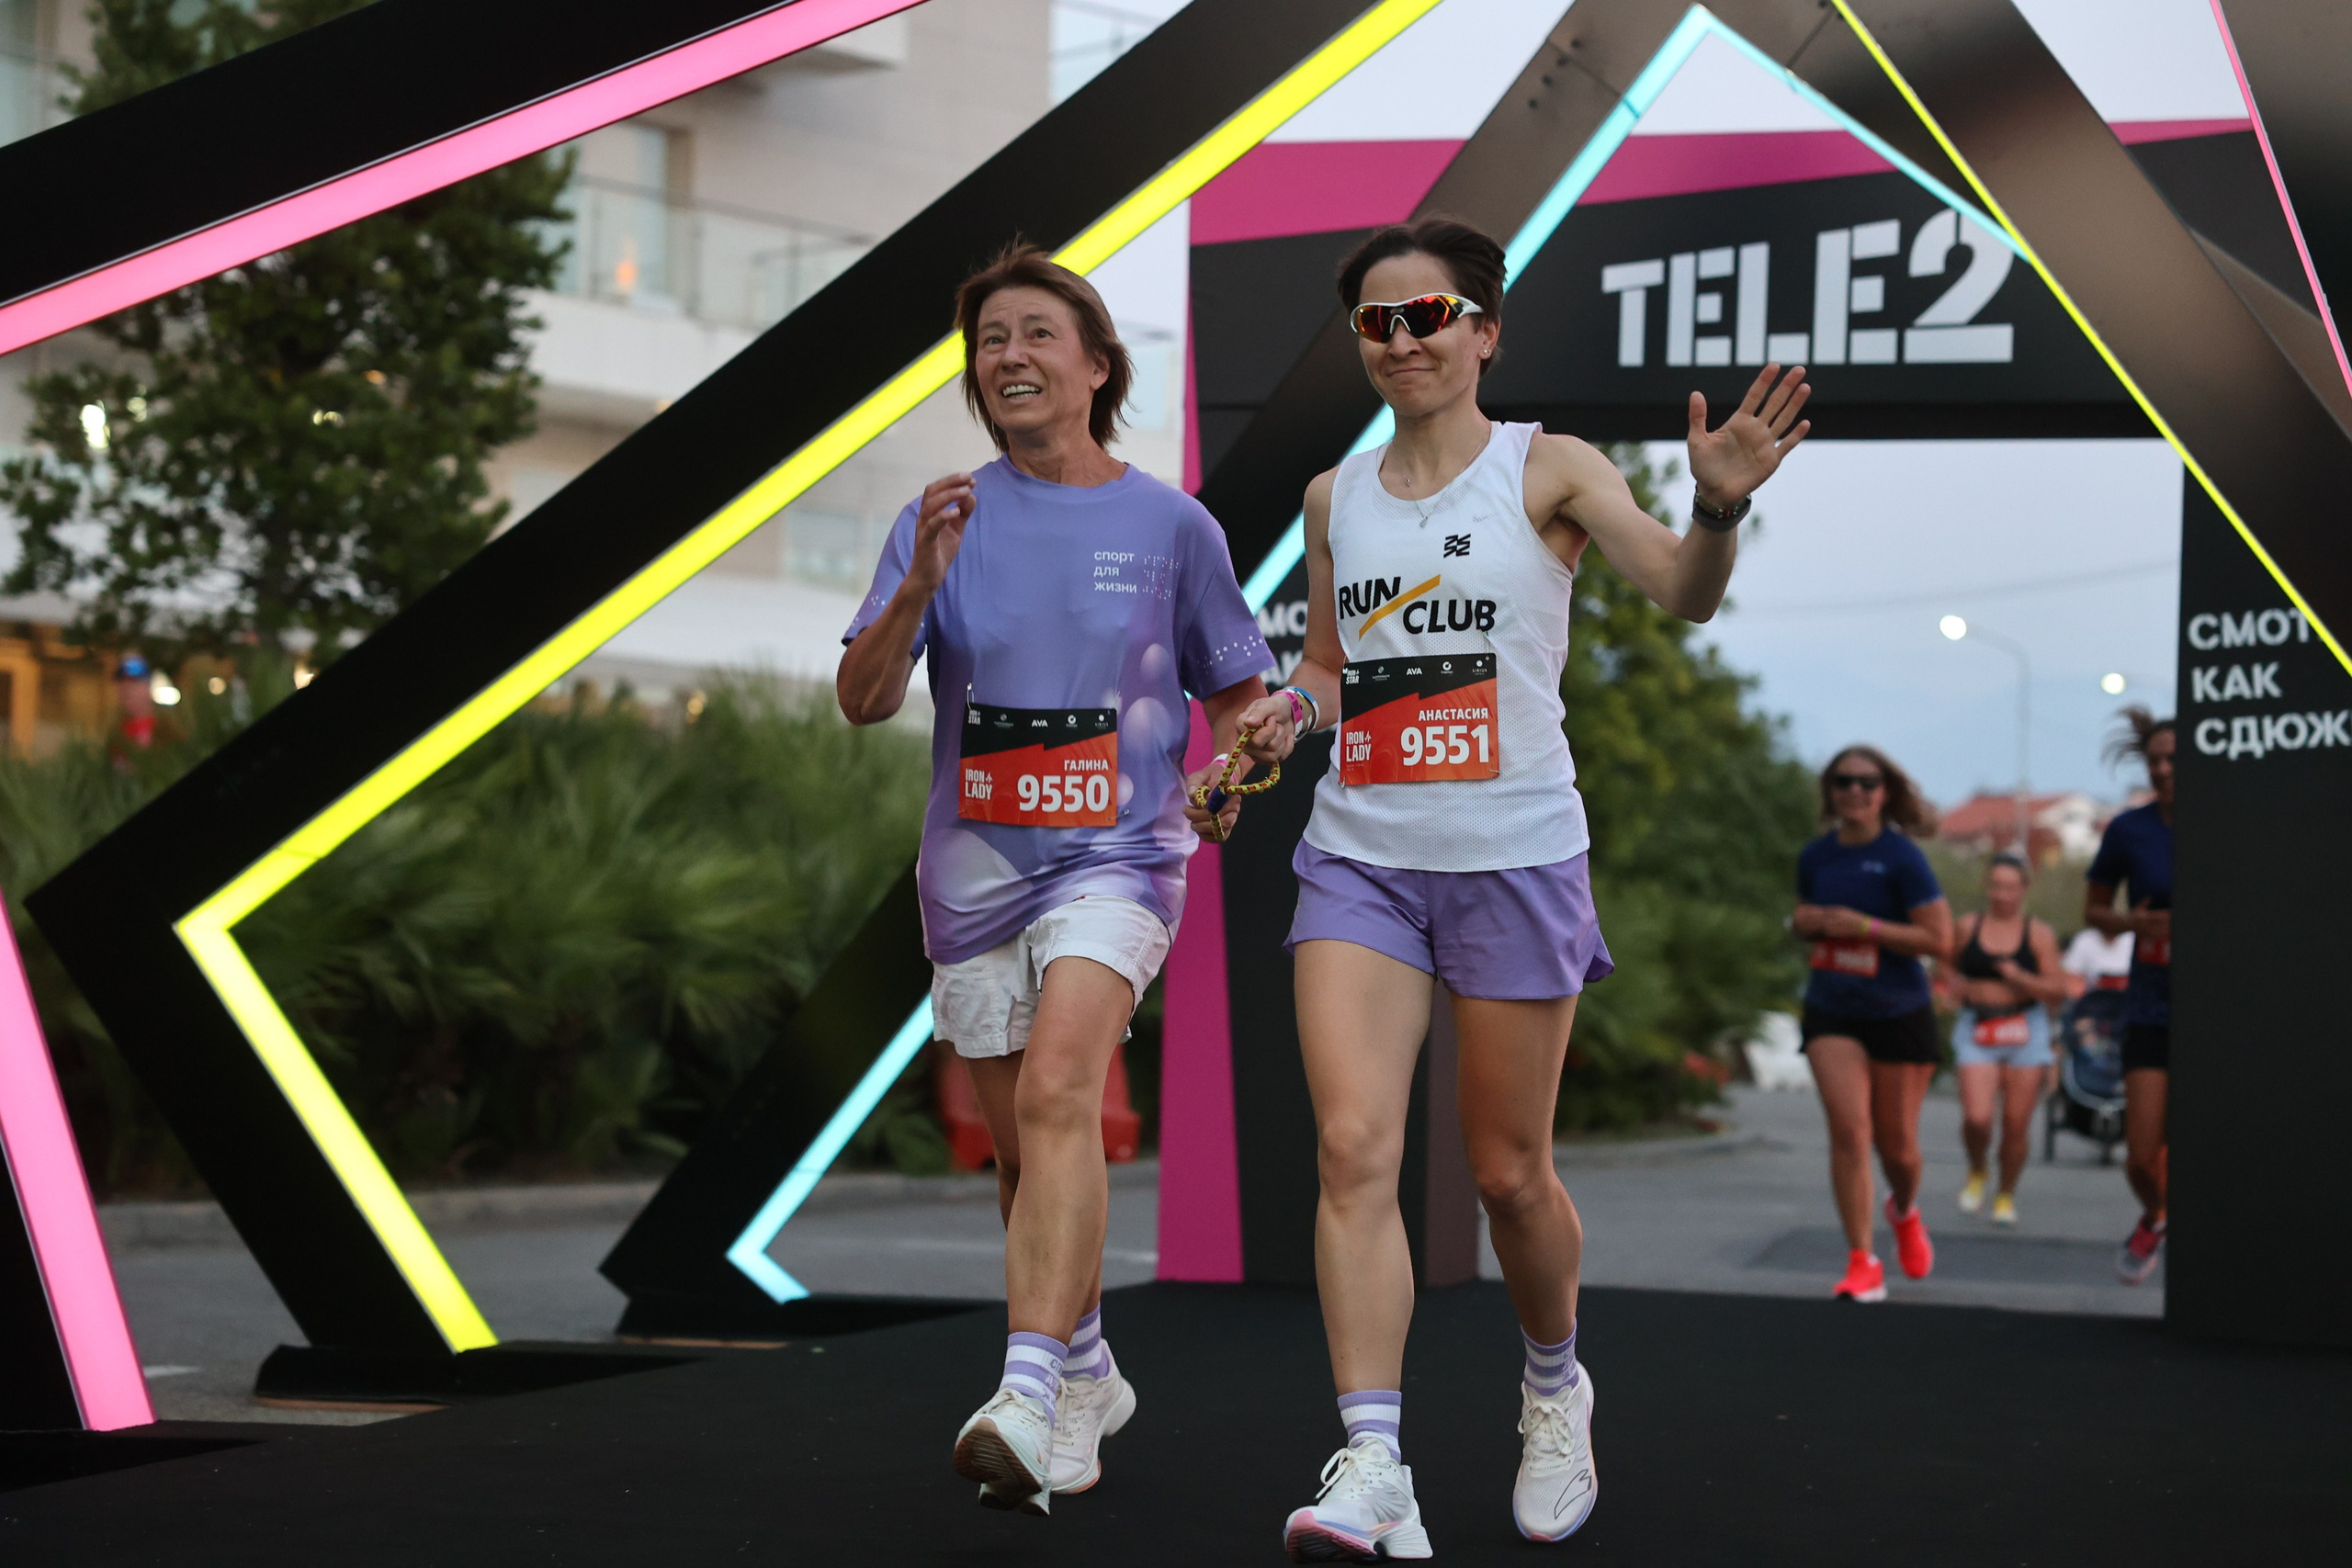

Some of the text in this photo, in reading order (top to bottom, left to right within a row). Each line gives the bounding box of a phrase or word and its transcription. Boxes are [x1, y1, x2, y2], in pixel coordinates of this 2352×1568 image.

[1601, 208, 2015, 367] TELE2
[1093, 551, 1135, 564] спорт
[1093, 566, 1119, 578] для
[1094, 581, 1137, 593] жизни
[1339, 576, 1401, 620] RUN
[1403, 599, 1497, 634] CLUB
[2188, 607, 2310, 650] СМОТ
[1406, 667, 1423, 675] AVA
[1345, 675, 1360, 685] STAR
[2192, 661, 2282, 703] КАК
[967, 716, 981, 725] STAR
[1419, 708, 1488, 721] АНАСТАСИЯ
[1031, 719, 1048, 728] AVA
[1346, 731, 1364, 745] IRON
[2194, 709, 2352, 761] СДЮЖ
[1346, 744, 1372, 761] LADY
[1400, 724, 1490, 766] 9551
[1064, 760, 1109, 771] ГАЛИНА
[966, 768, 985, 783] IRON
[966, 781, 992, 800] LADY
[1017, 773, 1110, 812] 9550
